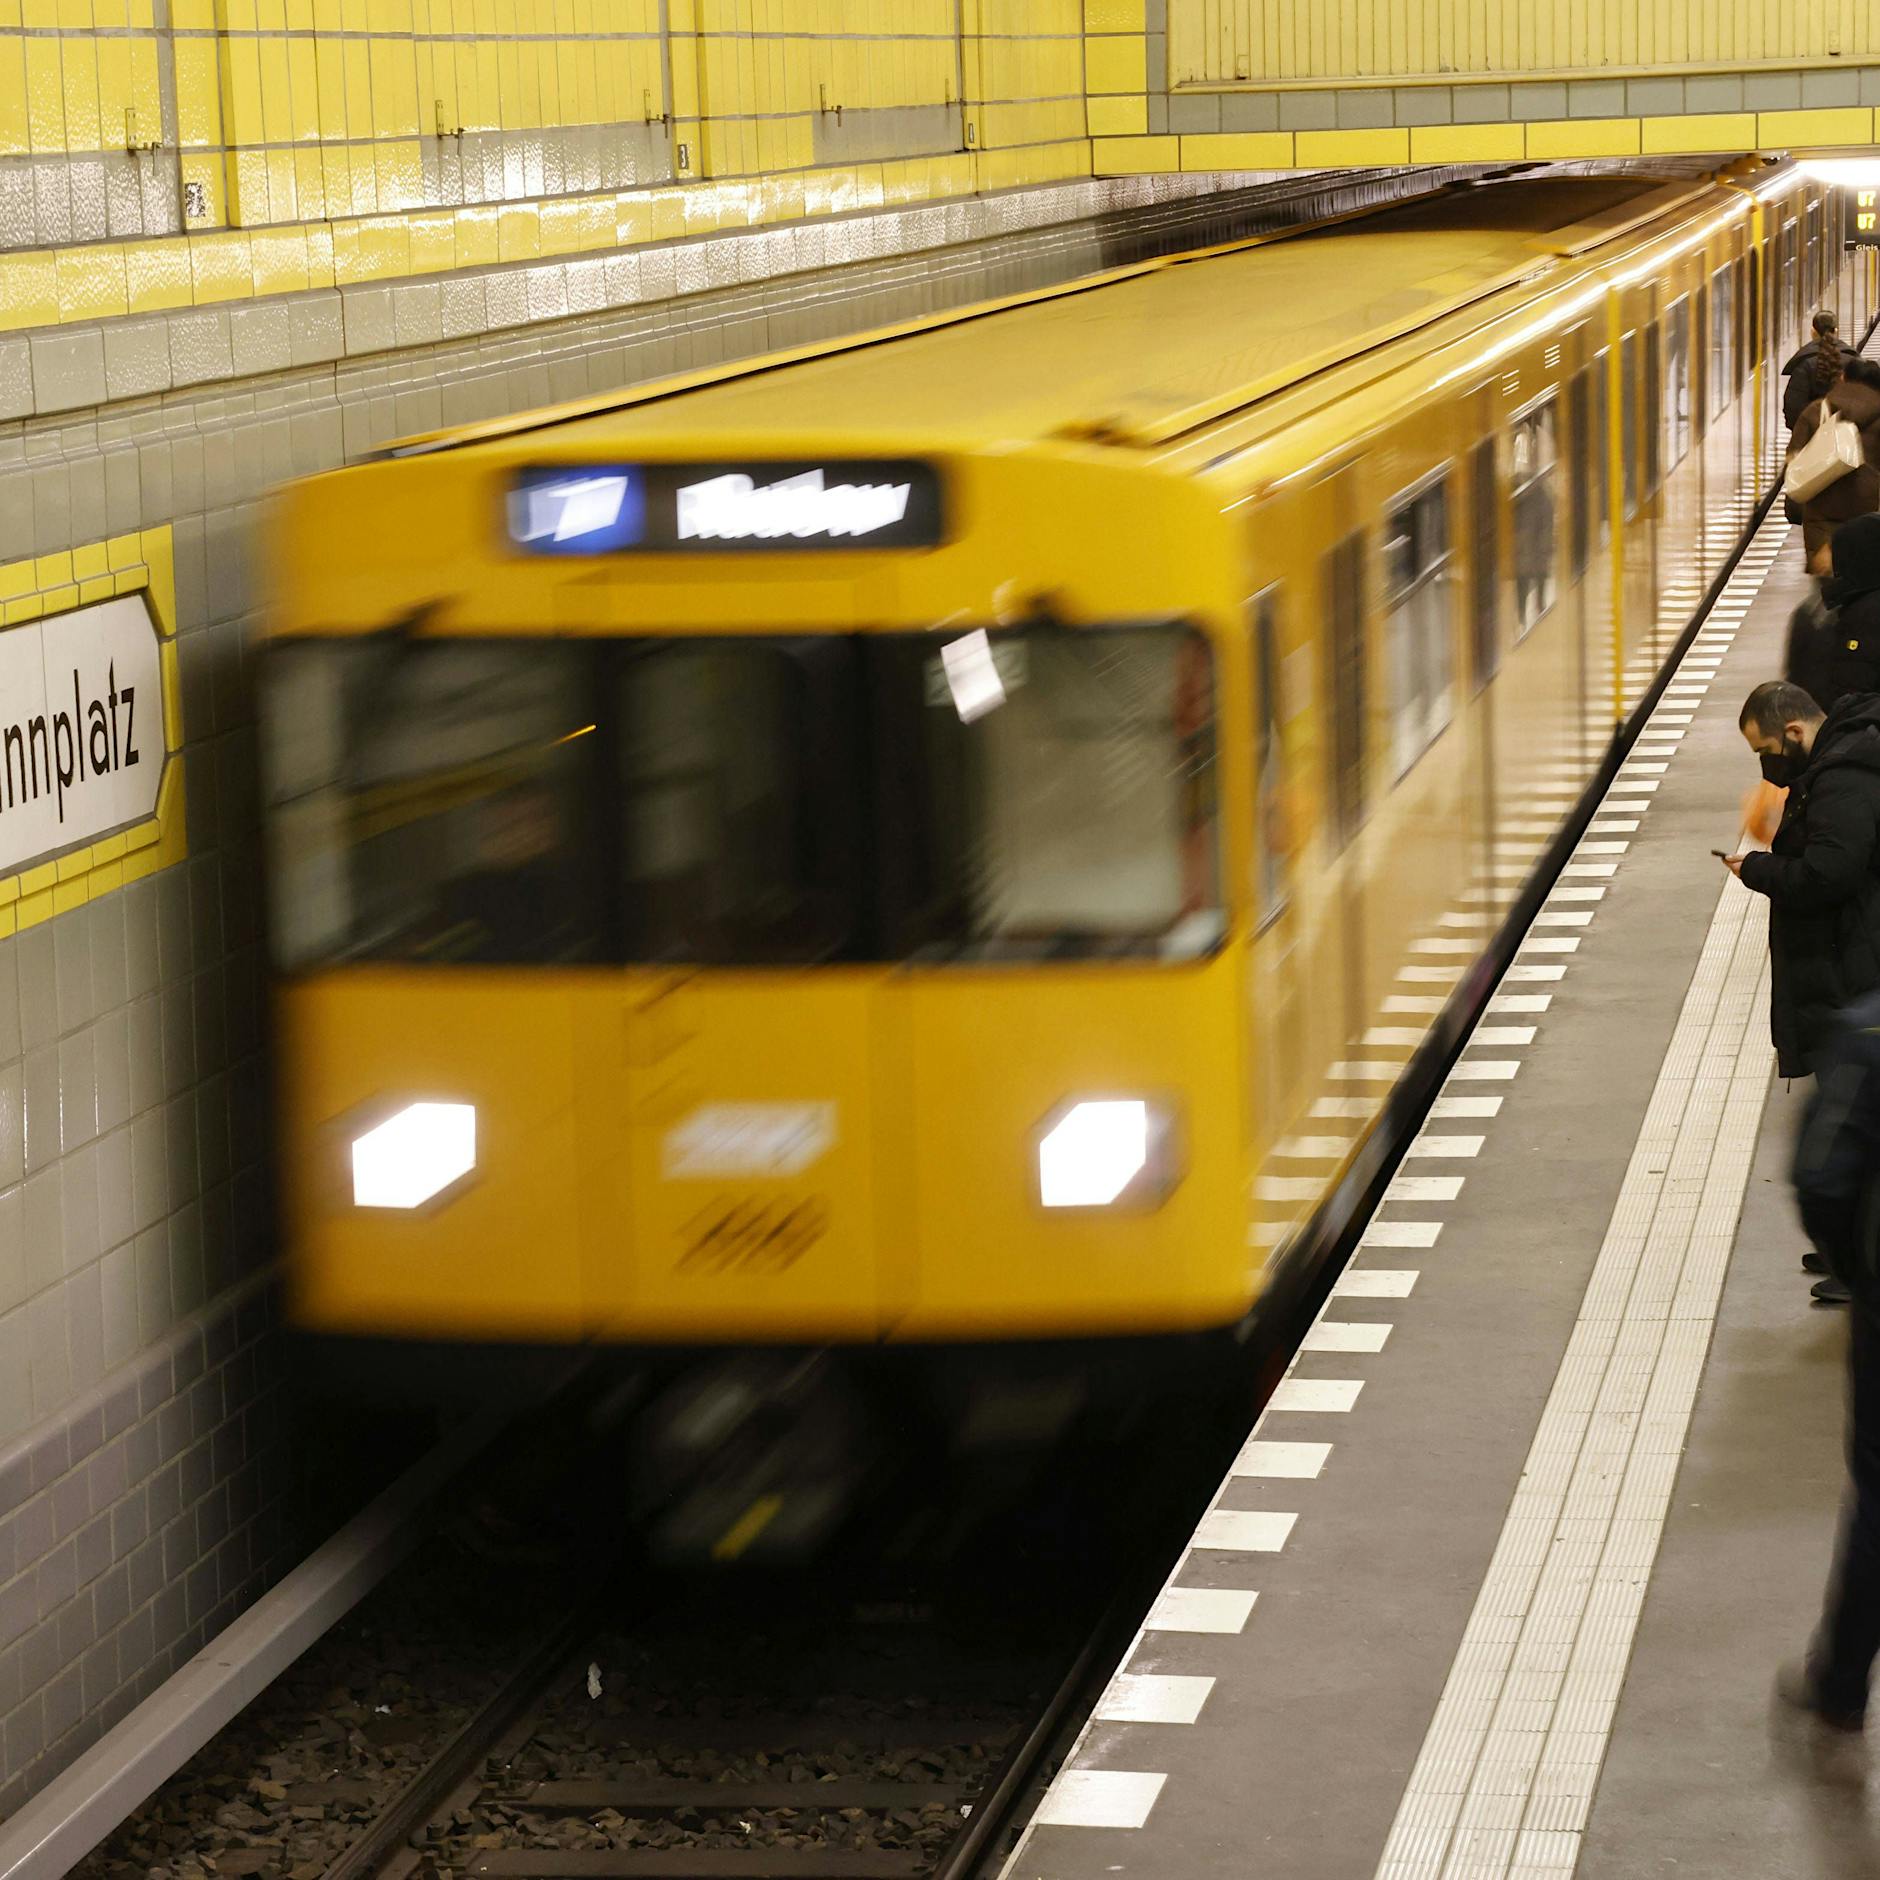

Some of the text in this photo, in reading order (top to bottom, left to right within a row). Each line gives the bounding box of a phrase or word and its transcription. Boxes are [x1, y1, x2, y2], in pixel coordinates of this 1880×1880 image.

[1857, 190, 1876, 207] U7
[1857, 212, 1876, 230] U7
[0, 656, 139, 824] nnplatz
